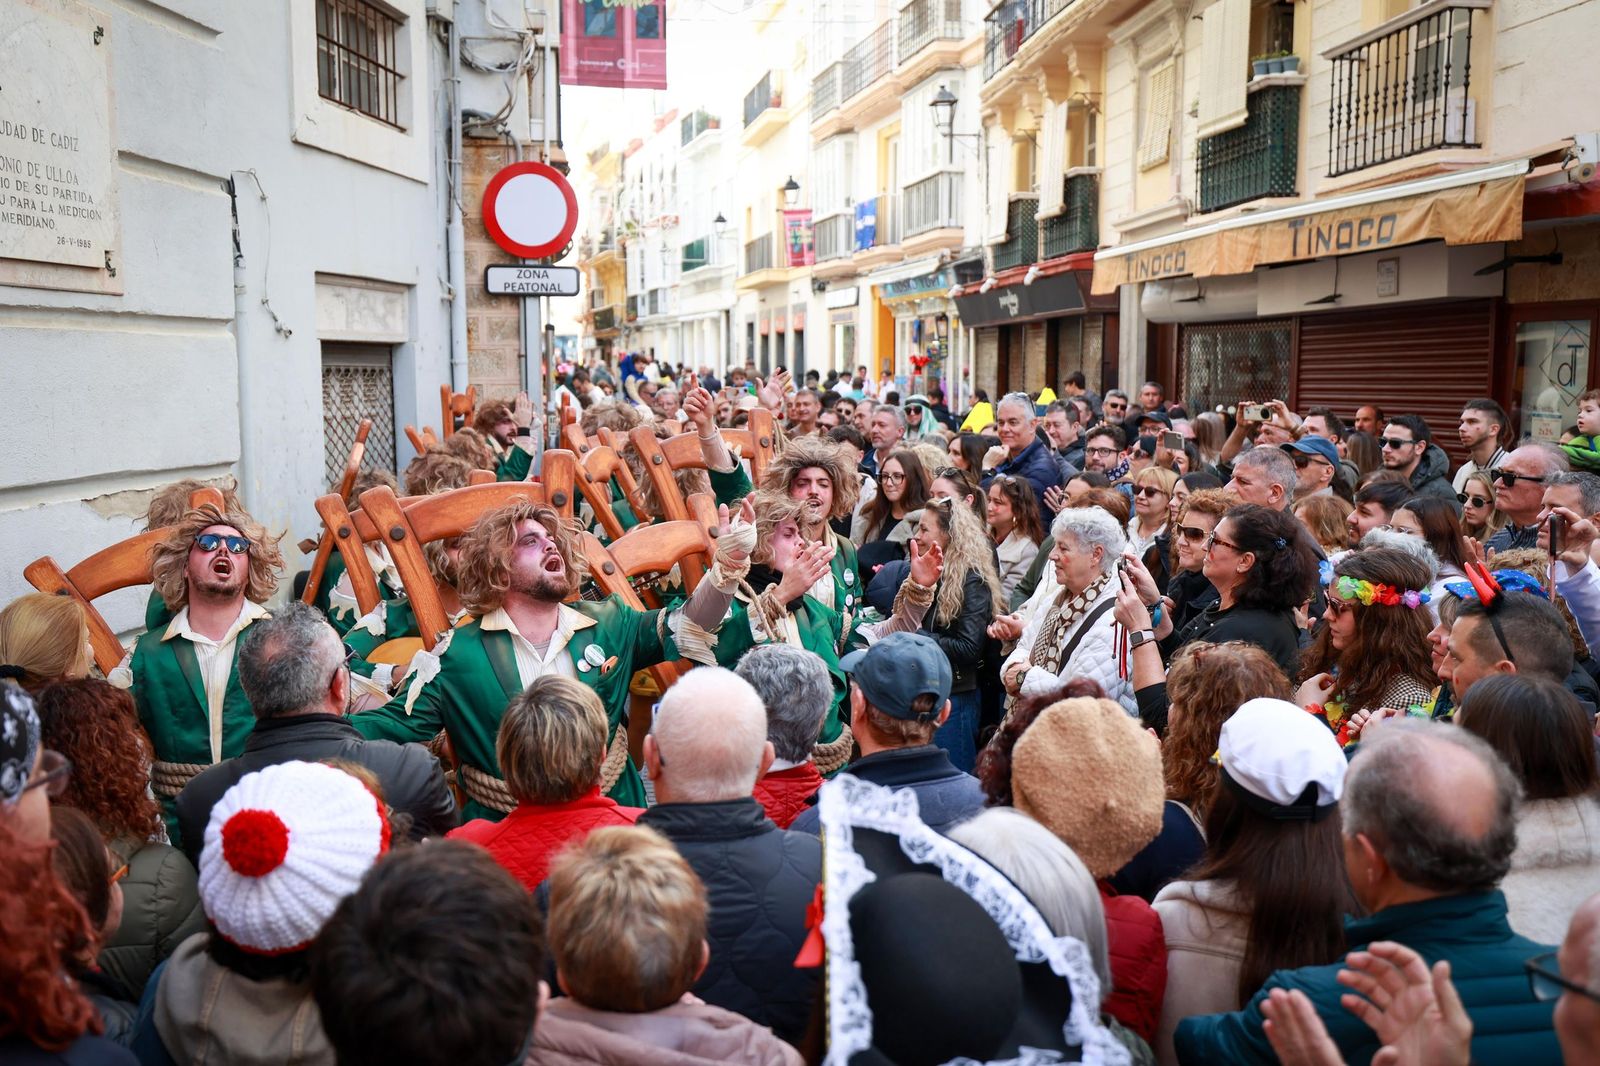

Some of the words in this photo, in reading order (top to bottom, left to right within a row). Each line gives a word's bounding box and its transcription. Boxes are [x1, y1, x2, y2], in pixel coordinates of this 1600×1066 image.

[32, 127, 46, 145] DE
[50, 132, 79, 152] CADIZ
[27, 161, 41, 179] DE
[45, 165, 79, 186] ULLOA
[15, 180, 30, 193] DE
[35, 183, 48, 196] SU
[52, 186, 94, 205] PARTIDA
[10, 195, 37, 211] PARA
[41, 201, 54, 214] LA
[58, 203, 102, 221] MEDICION
[516, 269, 549, 279] ZONA
[503, 282, 563, 292] PEATONAL
